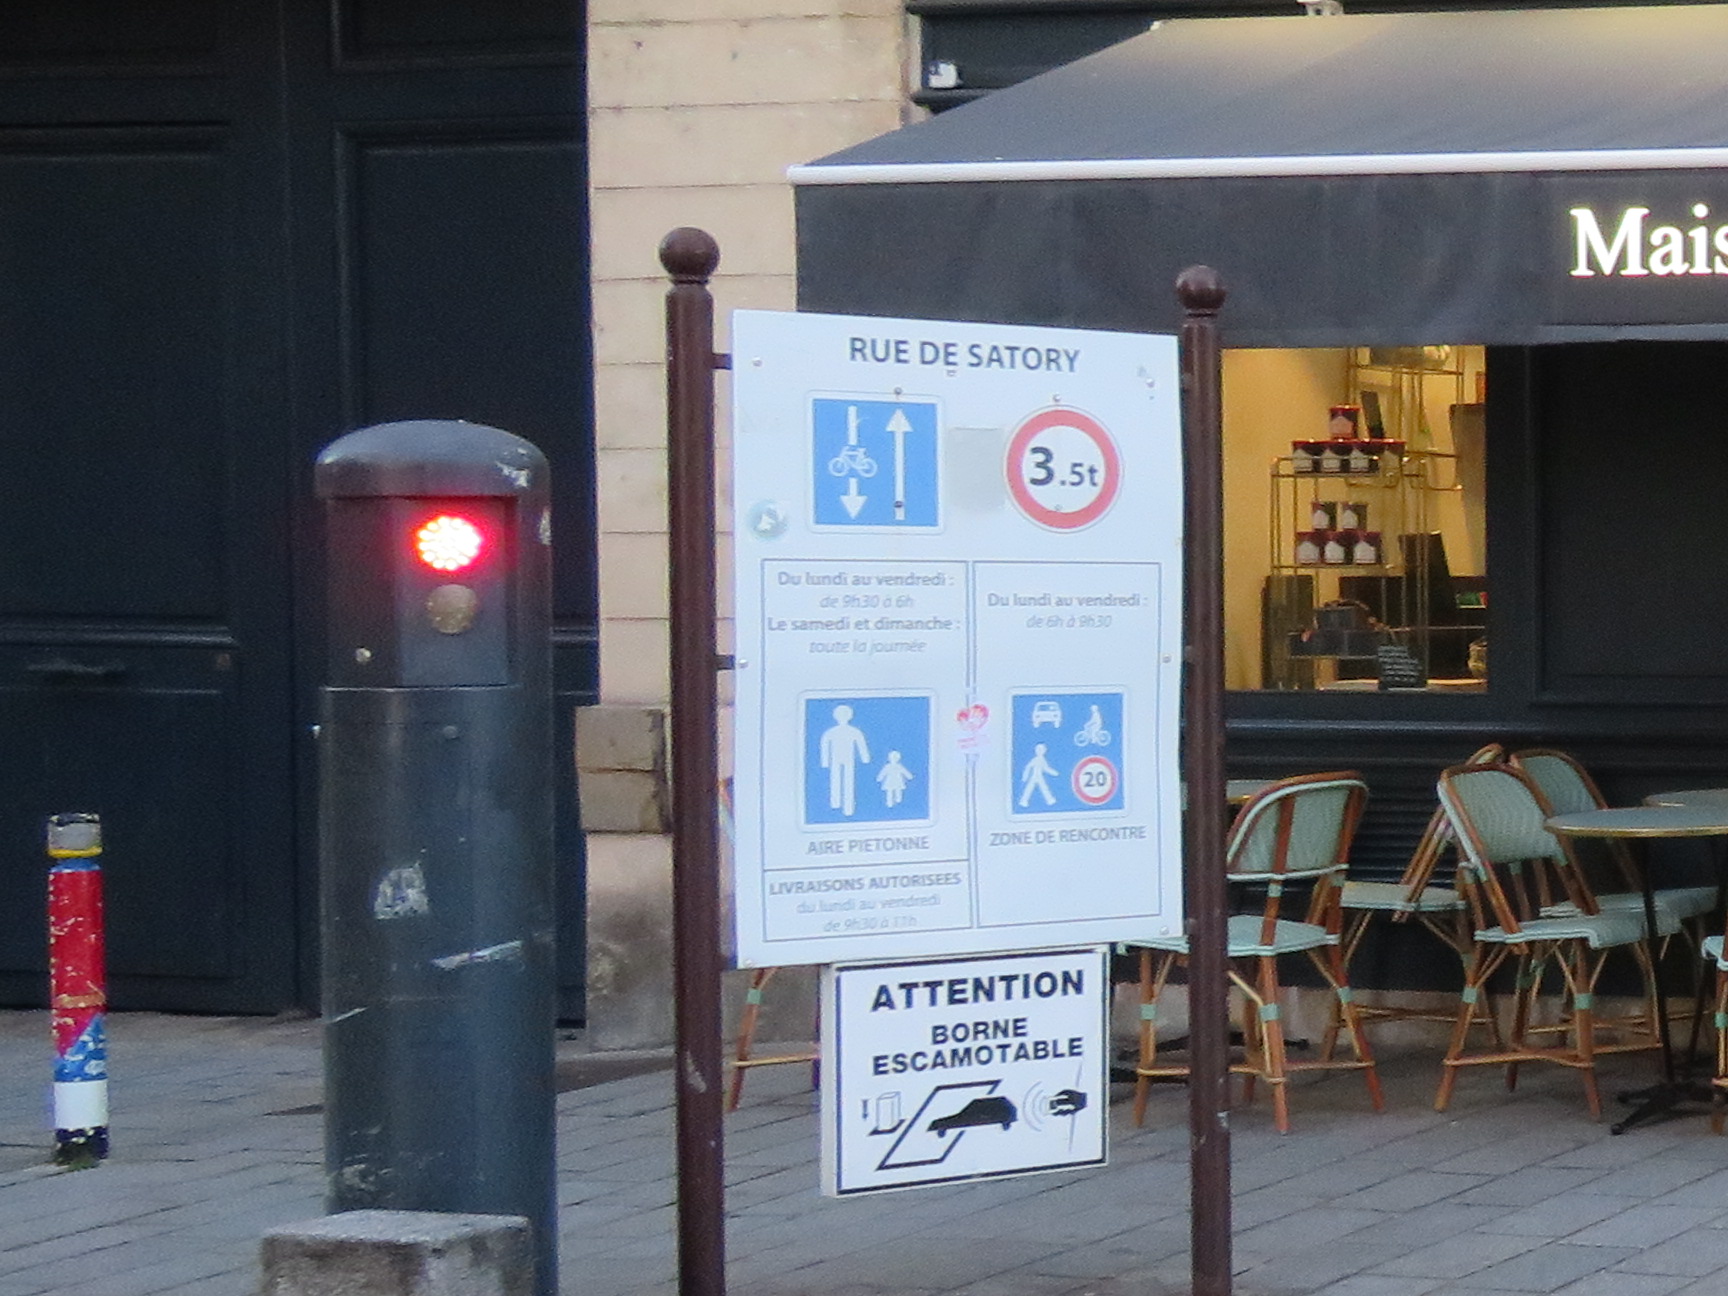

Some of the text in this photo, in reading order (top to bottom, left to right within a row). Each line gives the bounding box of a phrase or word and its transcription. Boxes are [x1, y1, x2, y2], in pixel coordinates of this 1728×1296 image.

[849, 337, 1081, 373] RUE DE SATORY
[777, 571, 801, 586] Du
[805, 570, 848, 586] lundi
[851, 574, 872, 586] au
[875, 571, 947, 586] vendredi
[819, 595, 839, 609] de
[843, 595, 879, 609] 9h30
[895, 595, 914, 609] 6h
[987, 593, 1010, 607] Du
[1013, 593, 1051, 607] lundi
[1055, 596, 1072, 607] au
[1076, 593, 1141, 607] vendredi
[767, 616, 787, 631] Le
[791, 616, 850, 631] samedi
[854, 618, 871, 631] et
[874, 615, 953, 631] dimanche
[1026, 615, 1043, 629] de
[809, 640, 849, 654] toute
[853, 639, 867, 654] la
[1083, 771, 1108, 788] 20
[988, 825, 1148, 847] ZONE DE RENCONTRE
[805, 835, 931, 856] AIRE PIETONNE
[769, 871, 962, 896] LIVRAISONS AUTORISEES
[859, 899, 876, 911] au
[880, 893, 941, 910] vendredi
[871, 969, 1085, 1013] ATTENTION
[931, 1017, 1029, 1045] BORNE
[873, 1036, 1085, 1076] ESCAMOTABLE
